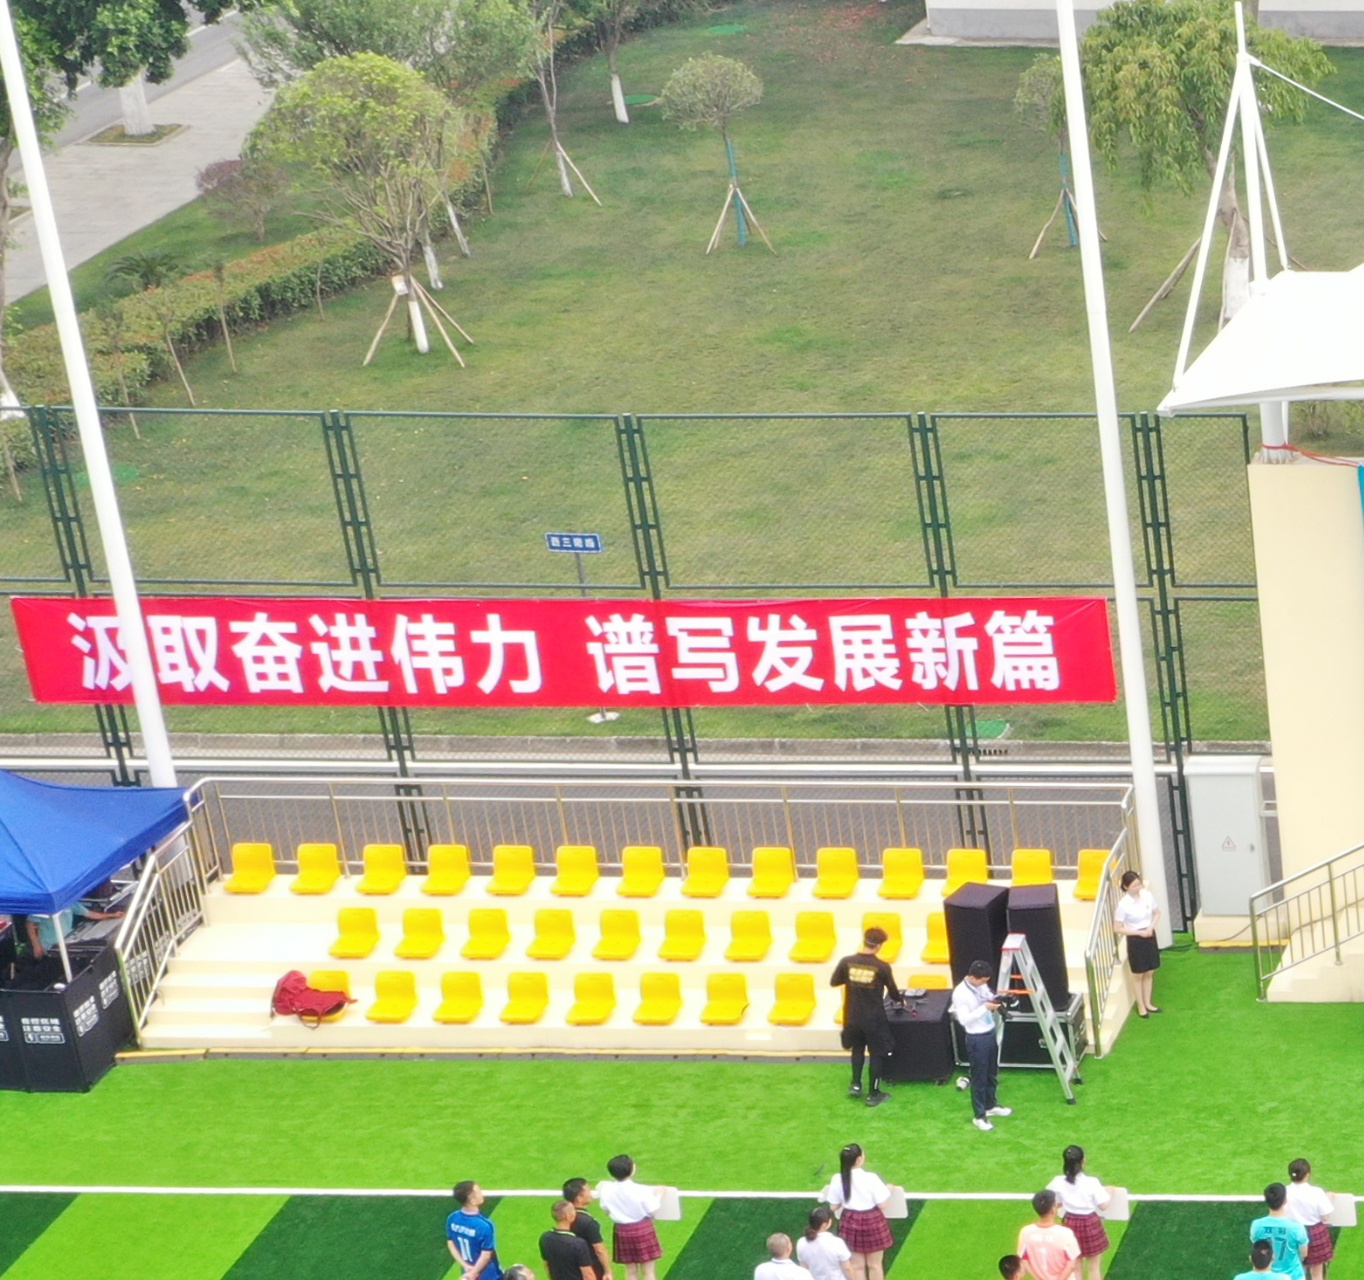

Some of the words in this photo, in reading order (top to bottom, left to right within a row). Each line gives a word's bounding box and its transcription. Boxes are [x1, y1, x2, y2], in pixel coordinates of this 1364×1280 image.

[67, 611, 543, 696] 汲取奋进伟力
[586, 610, 1061, 695] 谱写发展新篇
